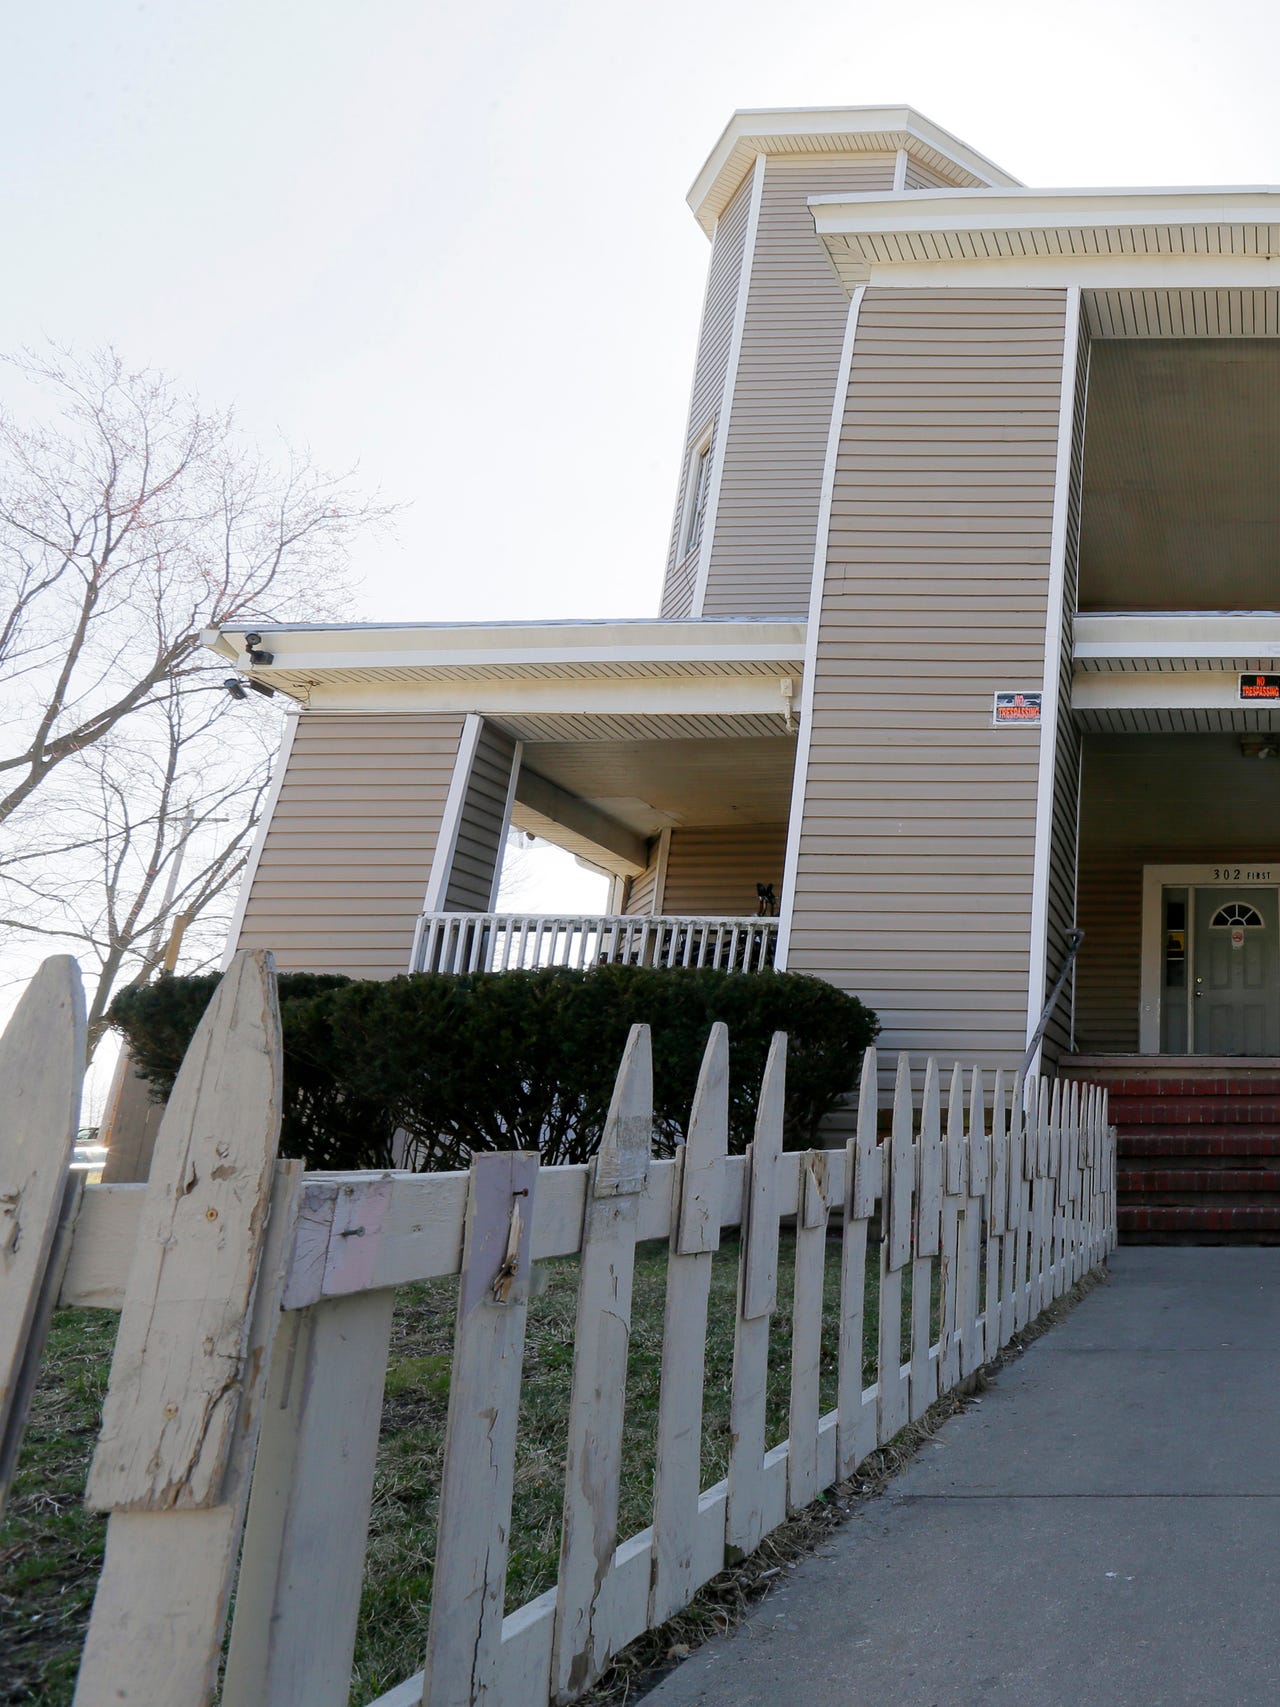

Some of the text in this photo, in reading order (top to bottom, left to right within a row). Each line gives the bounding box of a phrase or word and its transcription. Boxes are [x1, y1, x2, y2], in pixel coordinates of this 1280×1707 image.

[1256, 676, 1265, 686] NO
[1242, 687, 1279, 696] TRESPASSING
[1014, 695, 1024, 706] NO
[999, 707, 1040, 719] TRESPASSING
[1214, 869, 1271, 880] 302 FIRST
